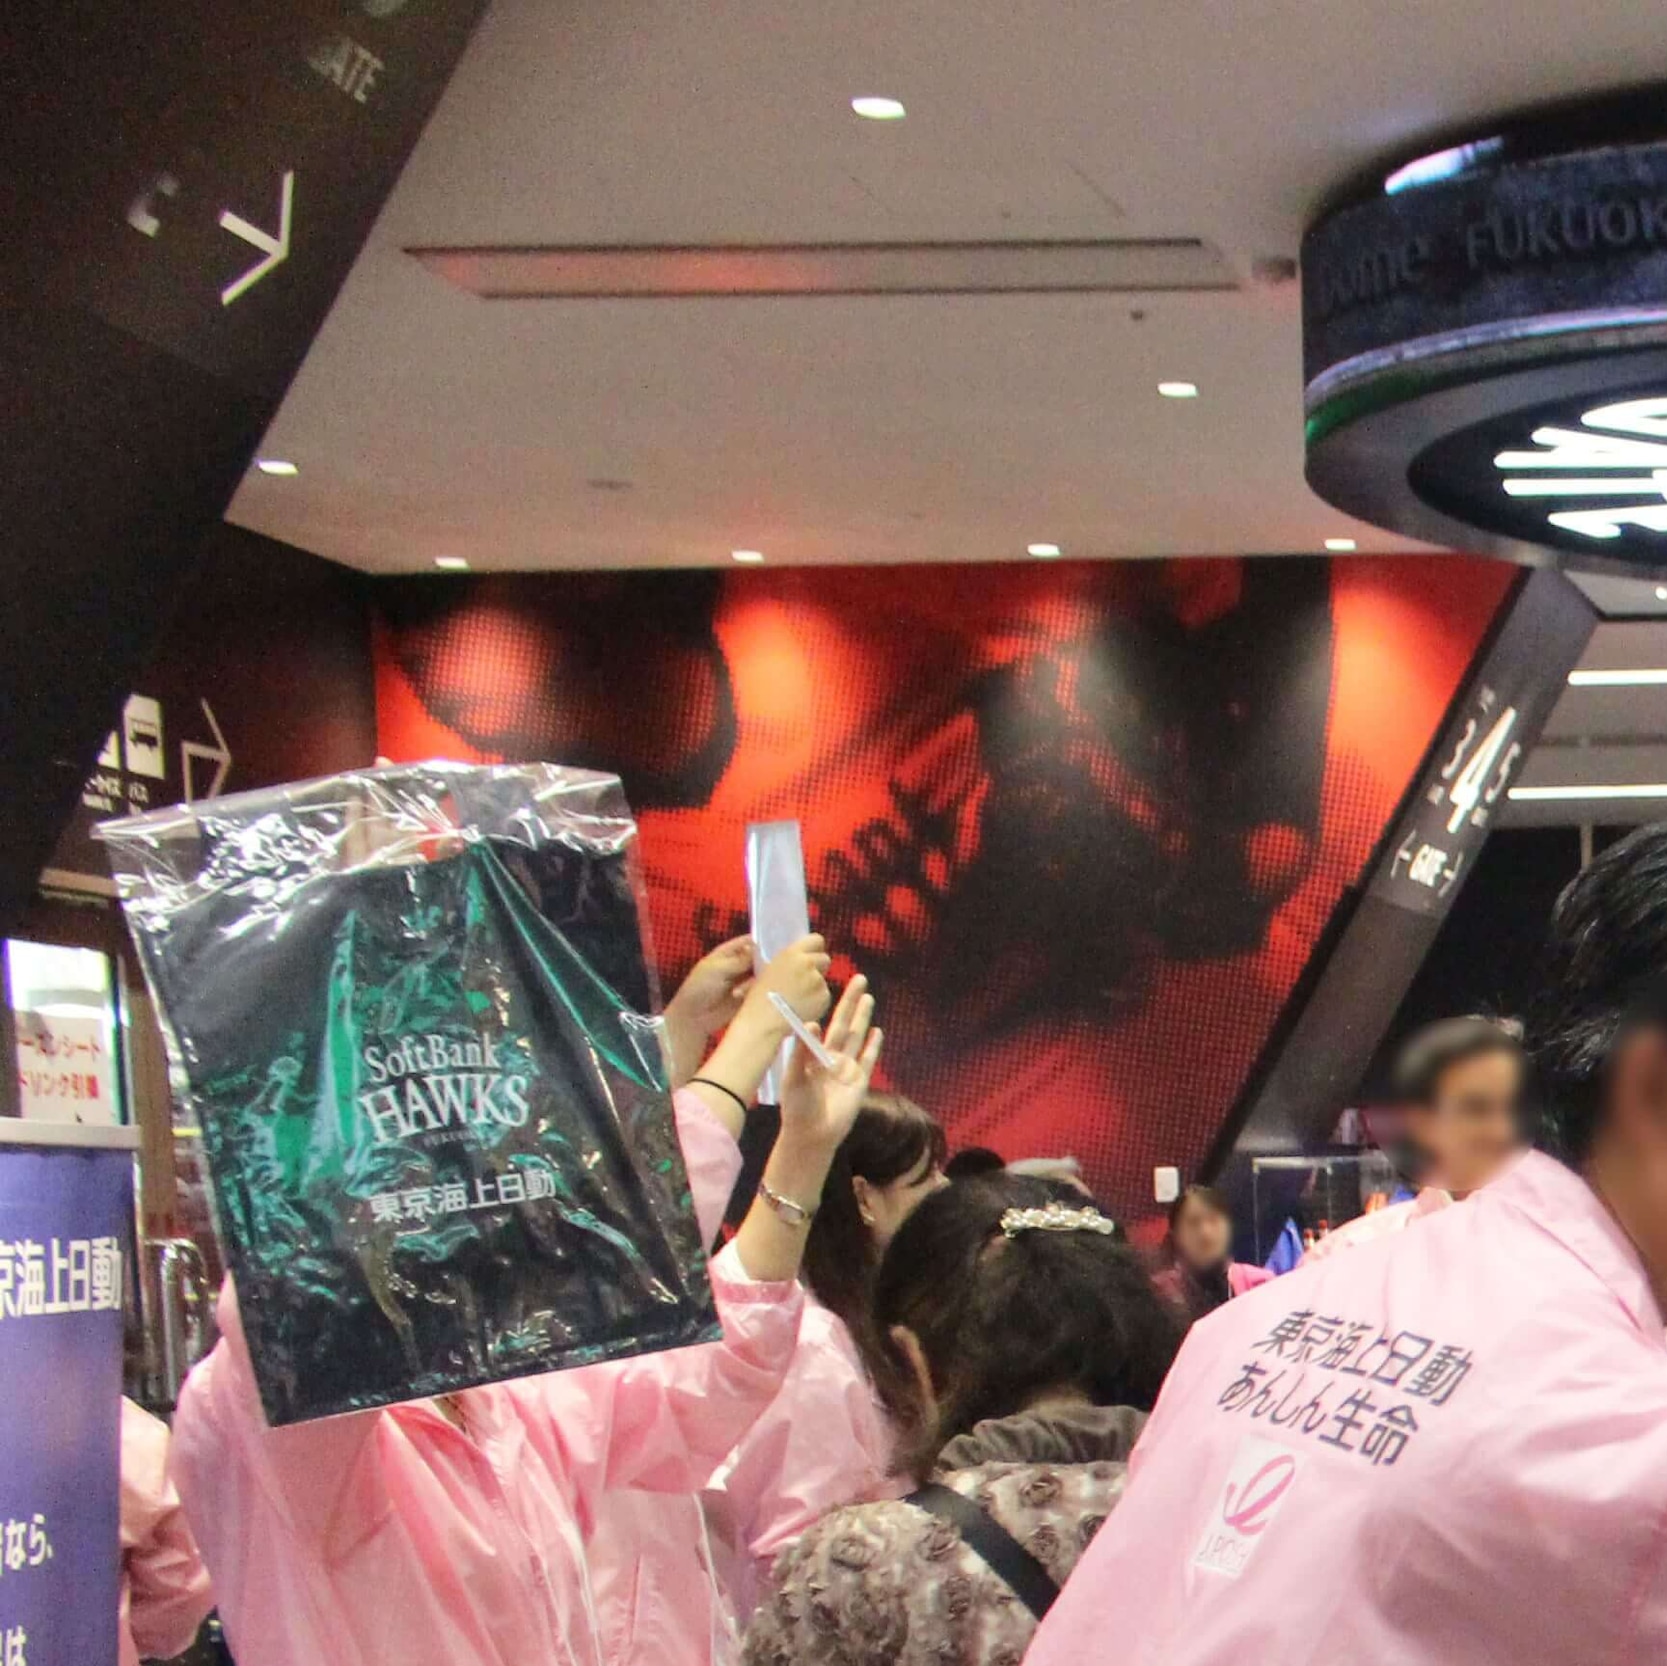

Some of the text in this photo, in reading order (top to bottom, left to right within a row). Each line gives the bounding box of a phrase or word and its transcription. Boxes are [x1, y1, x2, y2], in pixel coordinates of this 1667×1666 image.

[363, 1032, 502, 1083] SoftBank
[358, 1073, 530, 1144] HAWKS
[369, 1169, 557, 1223] 東京海上日動
[1251, 1308, 1473, 1407] 東京海上日動
[1216, 1360, 1419, 1466] あんしん生命
[0, 1513, 54, 1571] なら、
